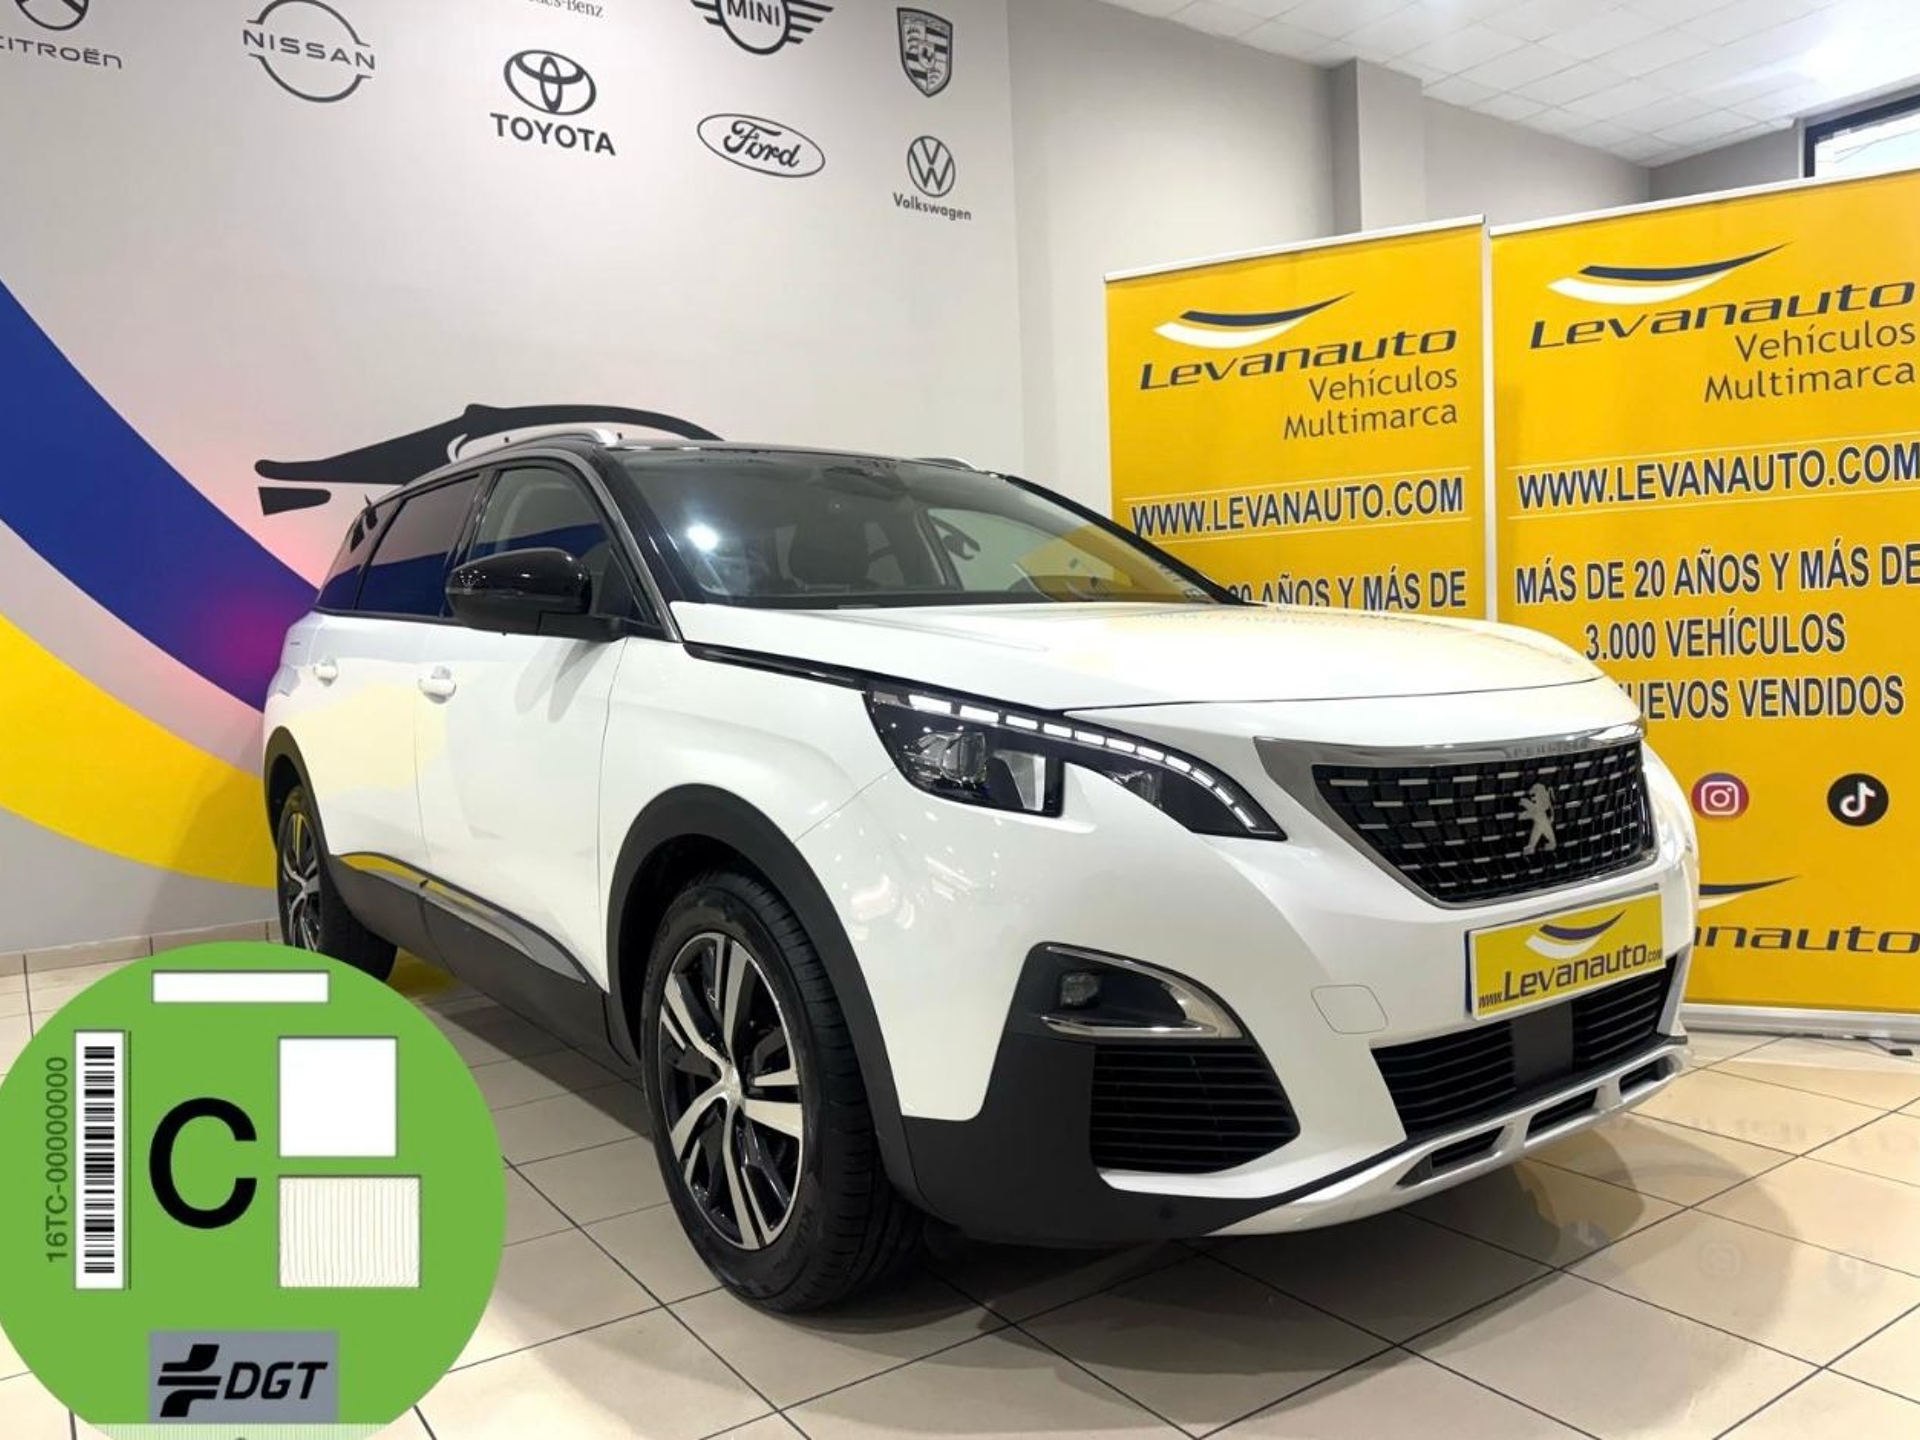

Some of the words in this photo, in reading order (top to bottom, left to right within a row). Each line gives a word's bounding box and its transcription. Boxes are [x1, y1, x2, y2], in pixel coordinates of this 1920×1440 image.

[242, 29, 375, 70] NISSAN
[490, 113, 616, 155] TOYOTA
[723, 119, 800, 168] Ford
[892, 191, 972, 220] Volkswagen
[1530, 281, 1915, 349] Levanauto
[1140, 330, 1457, 390] Levanauto
[1735, 320, 1916, 362] Vehículos
[1308, 365, 1458, 402] Vehículos
[1704, 362, 1914, 402] Multimarca
[1283, 403, 1457, 440] Multimarca
[1518, 440, 1920, 509] WWW.LEVANAUTO.COM
[1132, 477, 1463, 537] WWW.LEVANAUTO.COM
[1338, 576, 1355, 609] Y
[1363, 565, 1421, 611] MÁS
[1430, 570, 1466, 607] DE
[1516, 556, 1577, 604] MÁS
[1586, 560, 1624, 600] DE
[1634, 558, 1666, 597] 20
[1673, 547, 1761, 596] AÑOS
[1770, 552, 1790, 592] Y
[1800, 537, 1869, 588] MÁS
[1881, 542, 1920, 587] DE
[1585, 620, 1656, 661] 3.000
[1665, 607, 1845, 657] VEHÍCULOS
[1738, 674, 1904, 718] VENDIDOS
